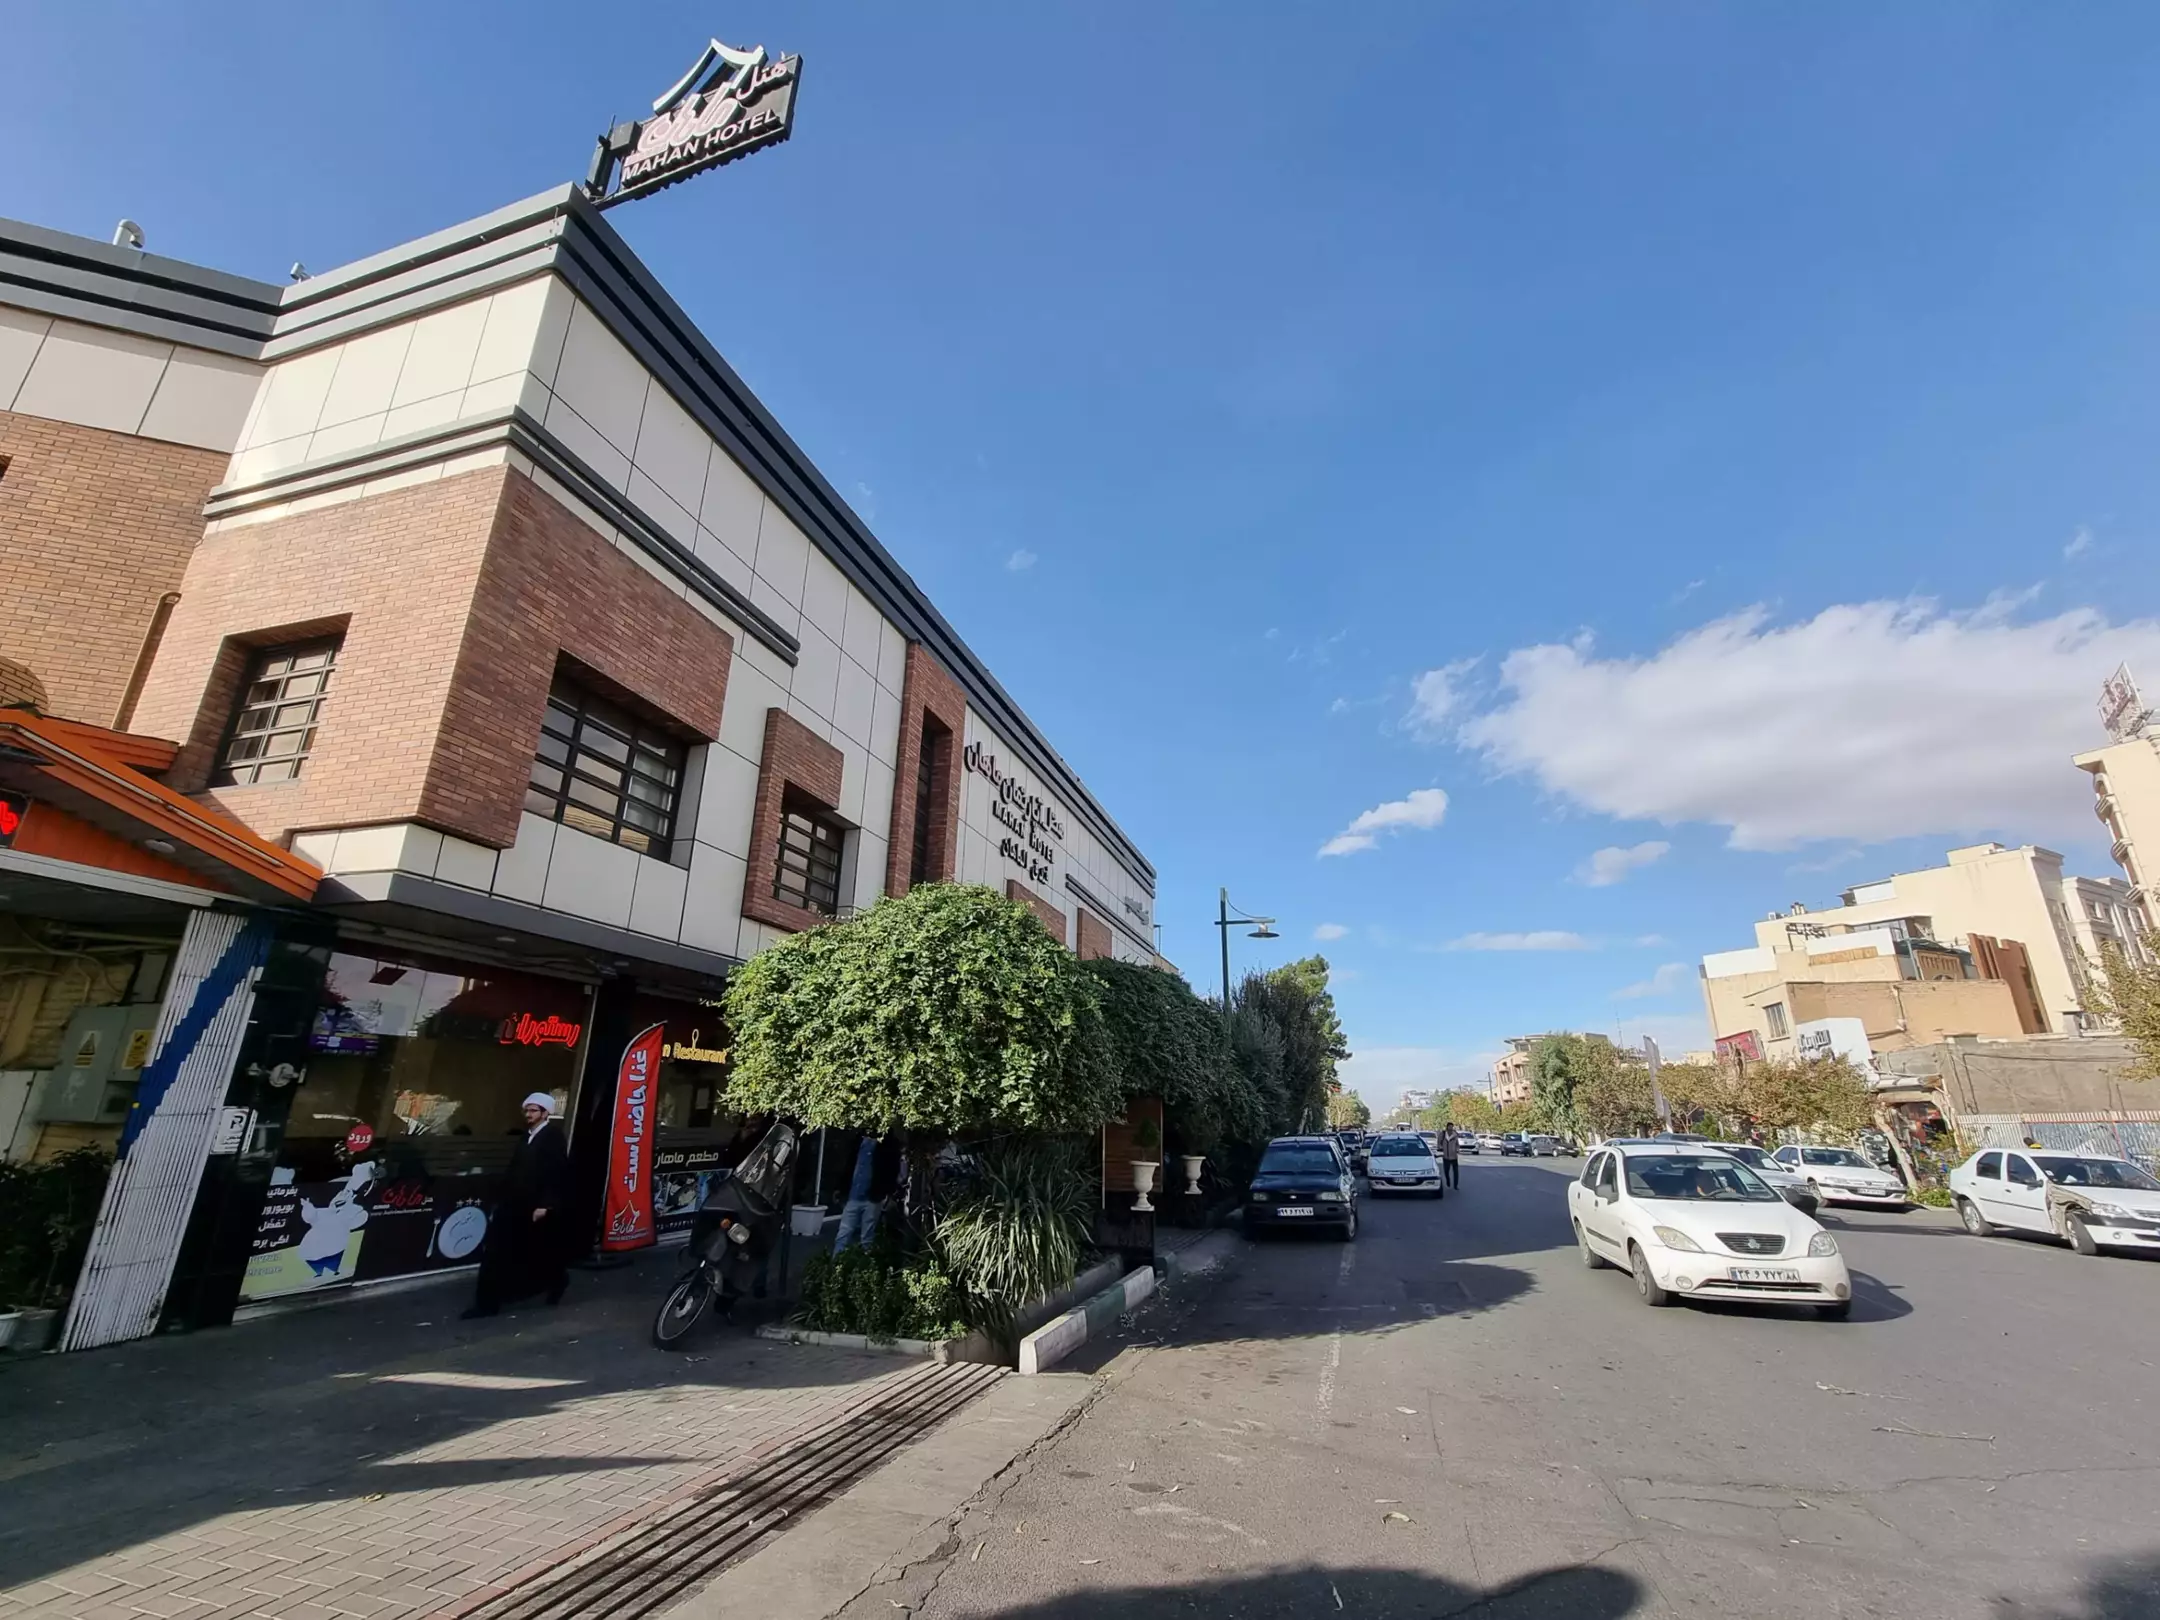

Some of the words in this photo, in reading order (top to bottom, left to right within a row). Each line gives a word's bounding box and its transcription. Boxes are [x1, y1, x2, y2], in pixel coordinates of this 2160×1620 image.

[622, 139, 700, 181] MAHAN
[704, 109, 777, 148] HOTEL
[964, 741, 1002, 787] ماهان
[628, 1049, 648, 1081] غذا
[673, 1036, 728, 1064] Restaurant
[626, 1085, 646, 1135] حاضر
[348, 1133, 371, 1144] ورود
[623, 1135, 643, 1192] است
[685, 1150, 719, 1167] مطعم
